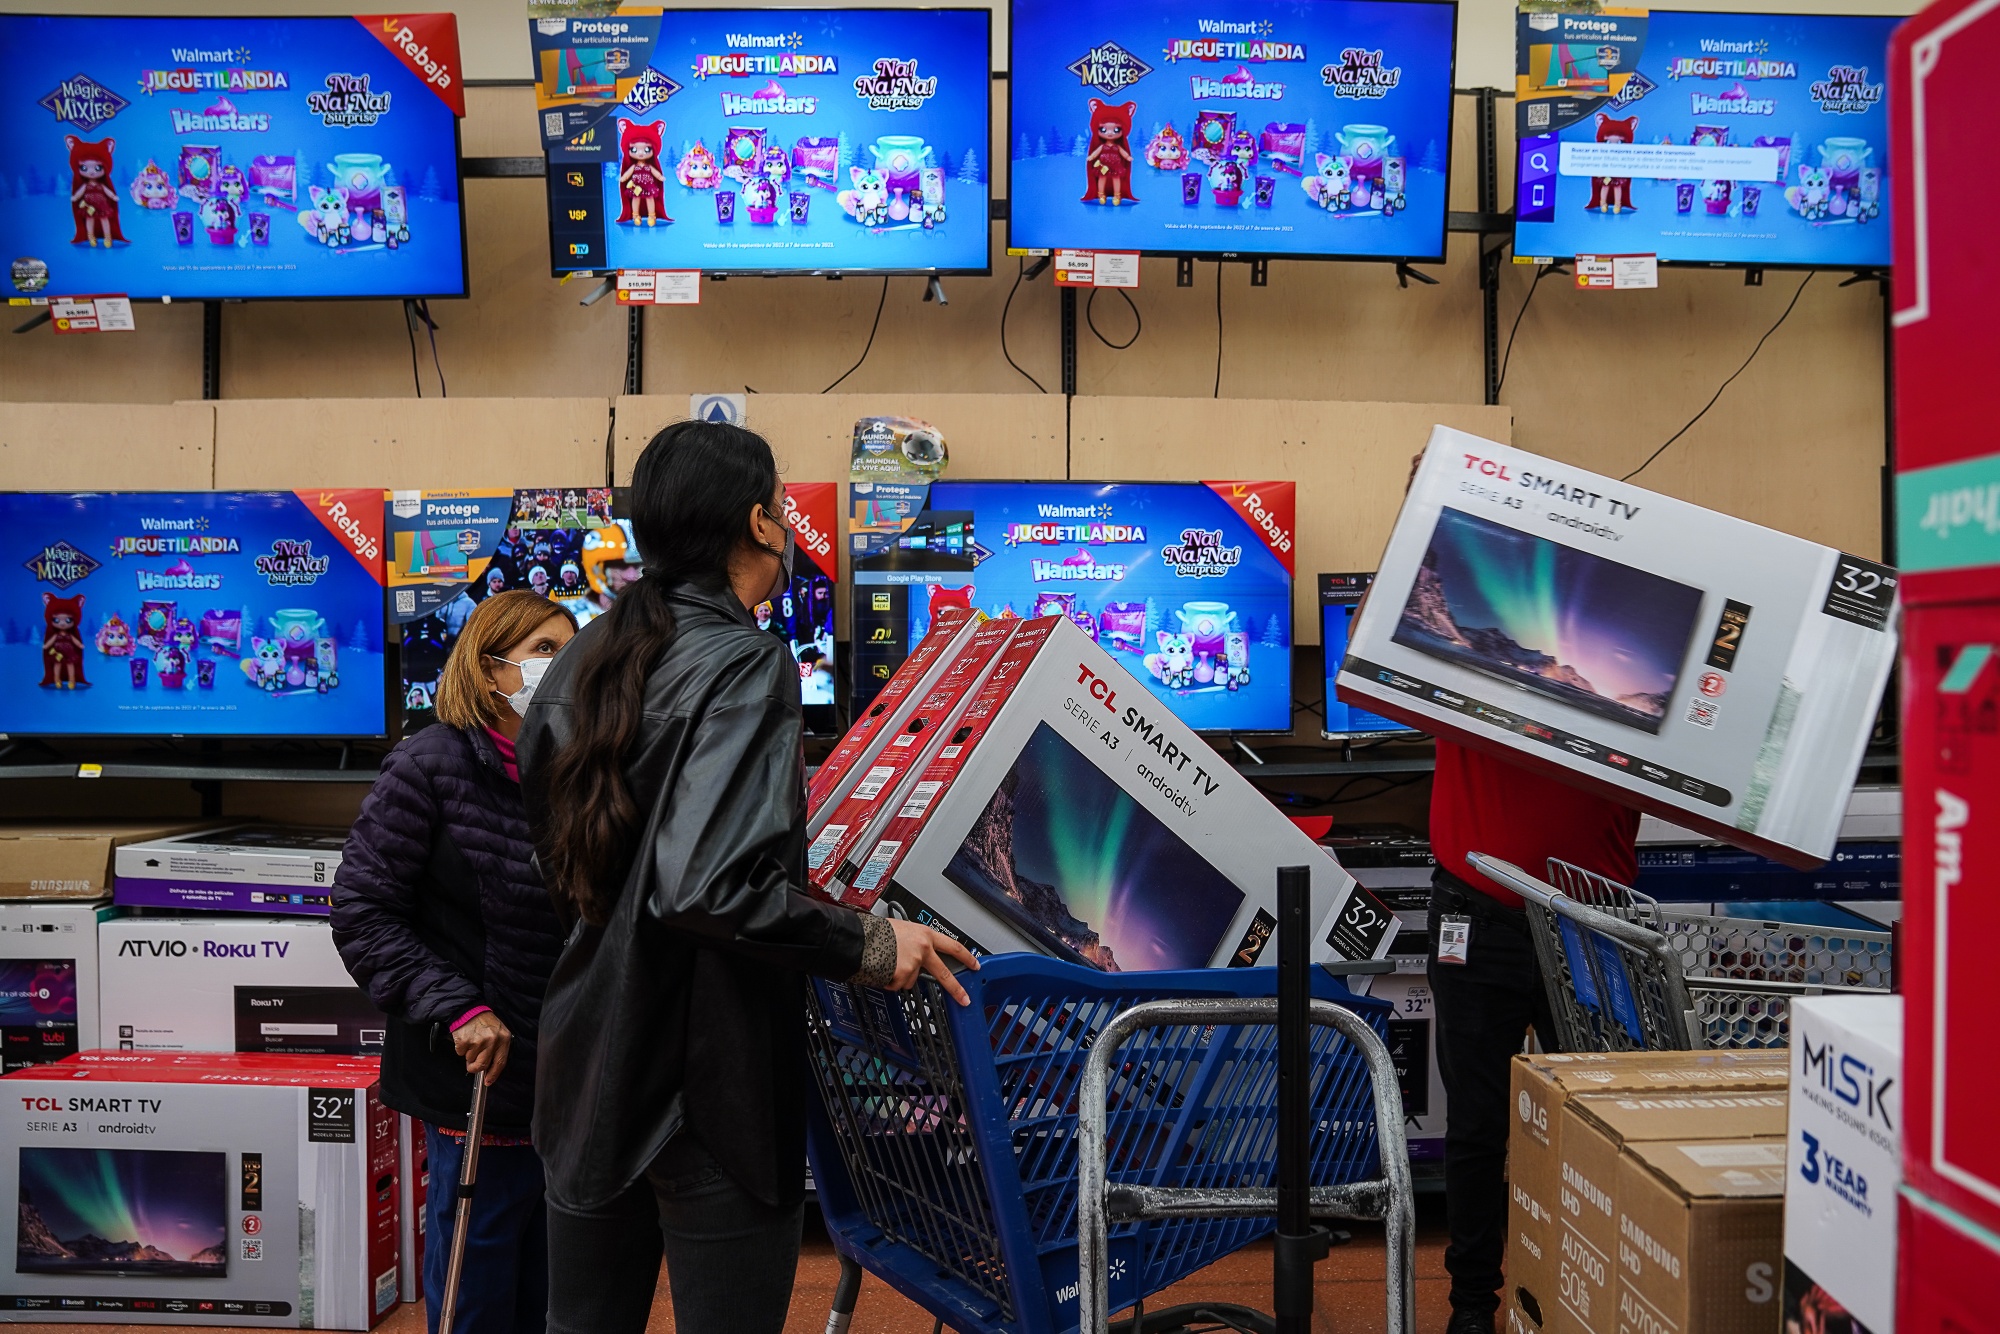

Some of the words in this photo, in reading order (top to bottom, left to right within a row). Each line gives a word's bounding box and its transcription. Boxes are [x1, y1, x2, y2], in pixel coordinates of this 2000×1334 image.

[572, 21, 629, 36] Protege
[1198, 20, 1257, 35] Walmart
[1564, 18, 1618, 34] Protege
[613, 36, 620, 44] al
[620, 36, 649, 44] máximo
[726, 33, 786, 48] Walmart
[1700, 39, 1754, 54] Walmart
[172, 48, 234, 63] Walmart
[392, 26, 454, 90] Rebaja
[613, 52, 621, 63] 3
[1090, 49, 1130, 66] Magic
[1170, 40, 1305, 61] JUGUETILANDIA
[1343, 49, 1382, 68] Na!
[699, 56, 837, 74] JUGUETILANDIA
[874, 59, 917, 79] Na!
[1673, 59, 1796, 79] JUGUETILANDIA
[144, 70, 289, 92] JUGUETILANDIA
[326, 73, 371, 95] Na!
[1322, 65, 1362, 85] Na!
[1363, 65, 1400, 86] Na!
[1831, 66, 1867, 85] Na!
[61, 82, 102, 101] Magic
[855, 76, 896, 96] Na!
[897, 76, 938, 96] Na!
[1191, 76, 1285, 101] Hamstars
[1335, 83, 1386, 98] Surprise
[1811, 81, 1847, 101] Na!
[1847, 82, 1883, 102] Na!
[306, 91, 349, 115] Na!
[350, 91, 392, 114] Na!
[721, 92, 818, 117] Hamstars
[870, 94, 924, 110] Surprise
[1691, 93, 1776, 116] Hamstars
[1821, 100, 1870, 114] Surprise
[171, 108, 271, 134] Hamstars
[324, 110, 378, 126] Surprise
[568, 209, 587, 221] USP
[876, 486, 910, 494] Protege
[1463, 453, 1511, 482] TCL
[1518, 472, 1603, 509] SMART
[1607, 498, 1641, 521] TV
[426, 503, 480, 517] Protege
[1038, 505, 1097, 518] Walmart
[1457, 481, 1499, 503] SERIE
[1501, 496, 1525, 510] A3
[1547, 511, 1625, 543] androidtv
[141, 518, 194, 531] Walmart
[327, 500, 379, 561] Rebaja
[437, 518, 464, 526] artículos
[783, 496, 831, 557] Rebaja
[1246, 491, 1293, 553] Rebaja
[465, 533, 473, 545] 3
[1009, 525, 1145, 543] JUGUETILANDIA
[1183, 530, 1220, 548] Na!
[117, 537, 239, 553] JUGUETILANDIA
[274, 541, 311, 558] Na!
[1163, 545, 1202, 564] Na!
[1203, 545, 1240, 564] Na!
[44, 547, 79, 563] Magic
[258, 555, 293, 574] Na!
[294, 555, 328, 574] Na!
[268, 571, 317, 585] Surprise
[887, 575, 909, 583] Google
[910, 575, 924, 583] Play
[1032, 558, 1125, 583] Hamstars
[1176, 562, 1227, 577] Surprise
[137, 571, 221, 591] Hamstars
[782, 598, 793, 617] 8
[1715, 623, 1742, 651] 2
[1706, 678, 1718, 691] 2
[1077, 662, 1117, 714] TCL
[1122, 706, 1192, 772] SMART
[1192, 765, 1220, 797] TV
[1063, 697, 1101, 734] SERIE
[1100, 731, 1120, 750] A3
[1137, 762, 1197, 818] androidtv
[30, 879, 91, 892] SAMSUNG
[1345, 896, 1387, 938] 32"
[932, 918, 959, 941] Chromecast
[1252, 921, 1270, 939] TOP
[118, 940, 188, 958] ATVIO
[203, 941, 257, 958] Roku
[260, 941, 290, 958] TV
[1238, 934, 1262, 964] 2
[250, 999, 272, 1007] Roku
[272, 999, 284, 1007] TV
[1405, 998, 1431, 1013] 32"
[42, 1032, 65, 1042] tubi
[21, 1097, 63, 1112] TCL
[68, 1097, 133, 1113] SMART
[137, 1099, 162, 1114] TV
[312, 1096, 353, 1120] 32"
[1616, 1097, 1785, 1110] SAMSUNG
[1532, 1101, 1548, 1132] LG
[26, 1121, 58, 1132] SERIE
[62, 1122, 78, 1132] A3
[98, 1122, 157, 1135] androidtv
[375, 1117, 393, 1139] 32"
[1800, 1129, 1821, 1185] 3
[1823, 1150, 1869, 1202] YEAR
[244, 1171, 259, 1194] 2
[1561, 1161, 1613, 1218] SAMSUNG
[1513, 1183, 1531, 1213] UHD
[1561, 1185, 1581, 1218] UHD
[248, 1220, 255, 1231] 2
[1520, 1232, 1542, 1261] 50UQ80
[1619, 1212, 1681, 1281] SAMSUNG
[1561, 1231, 1606, 1289] AU7000
[1619, 1240, 1641, 1277] UHD
[1745, 1261, 1775, 1303] S
[1055, 1281, 1080, 1305] Wal
